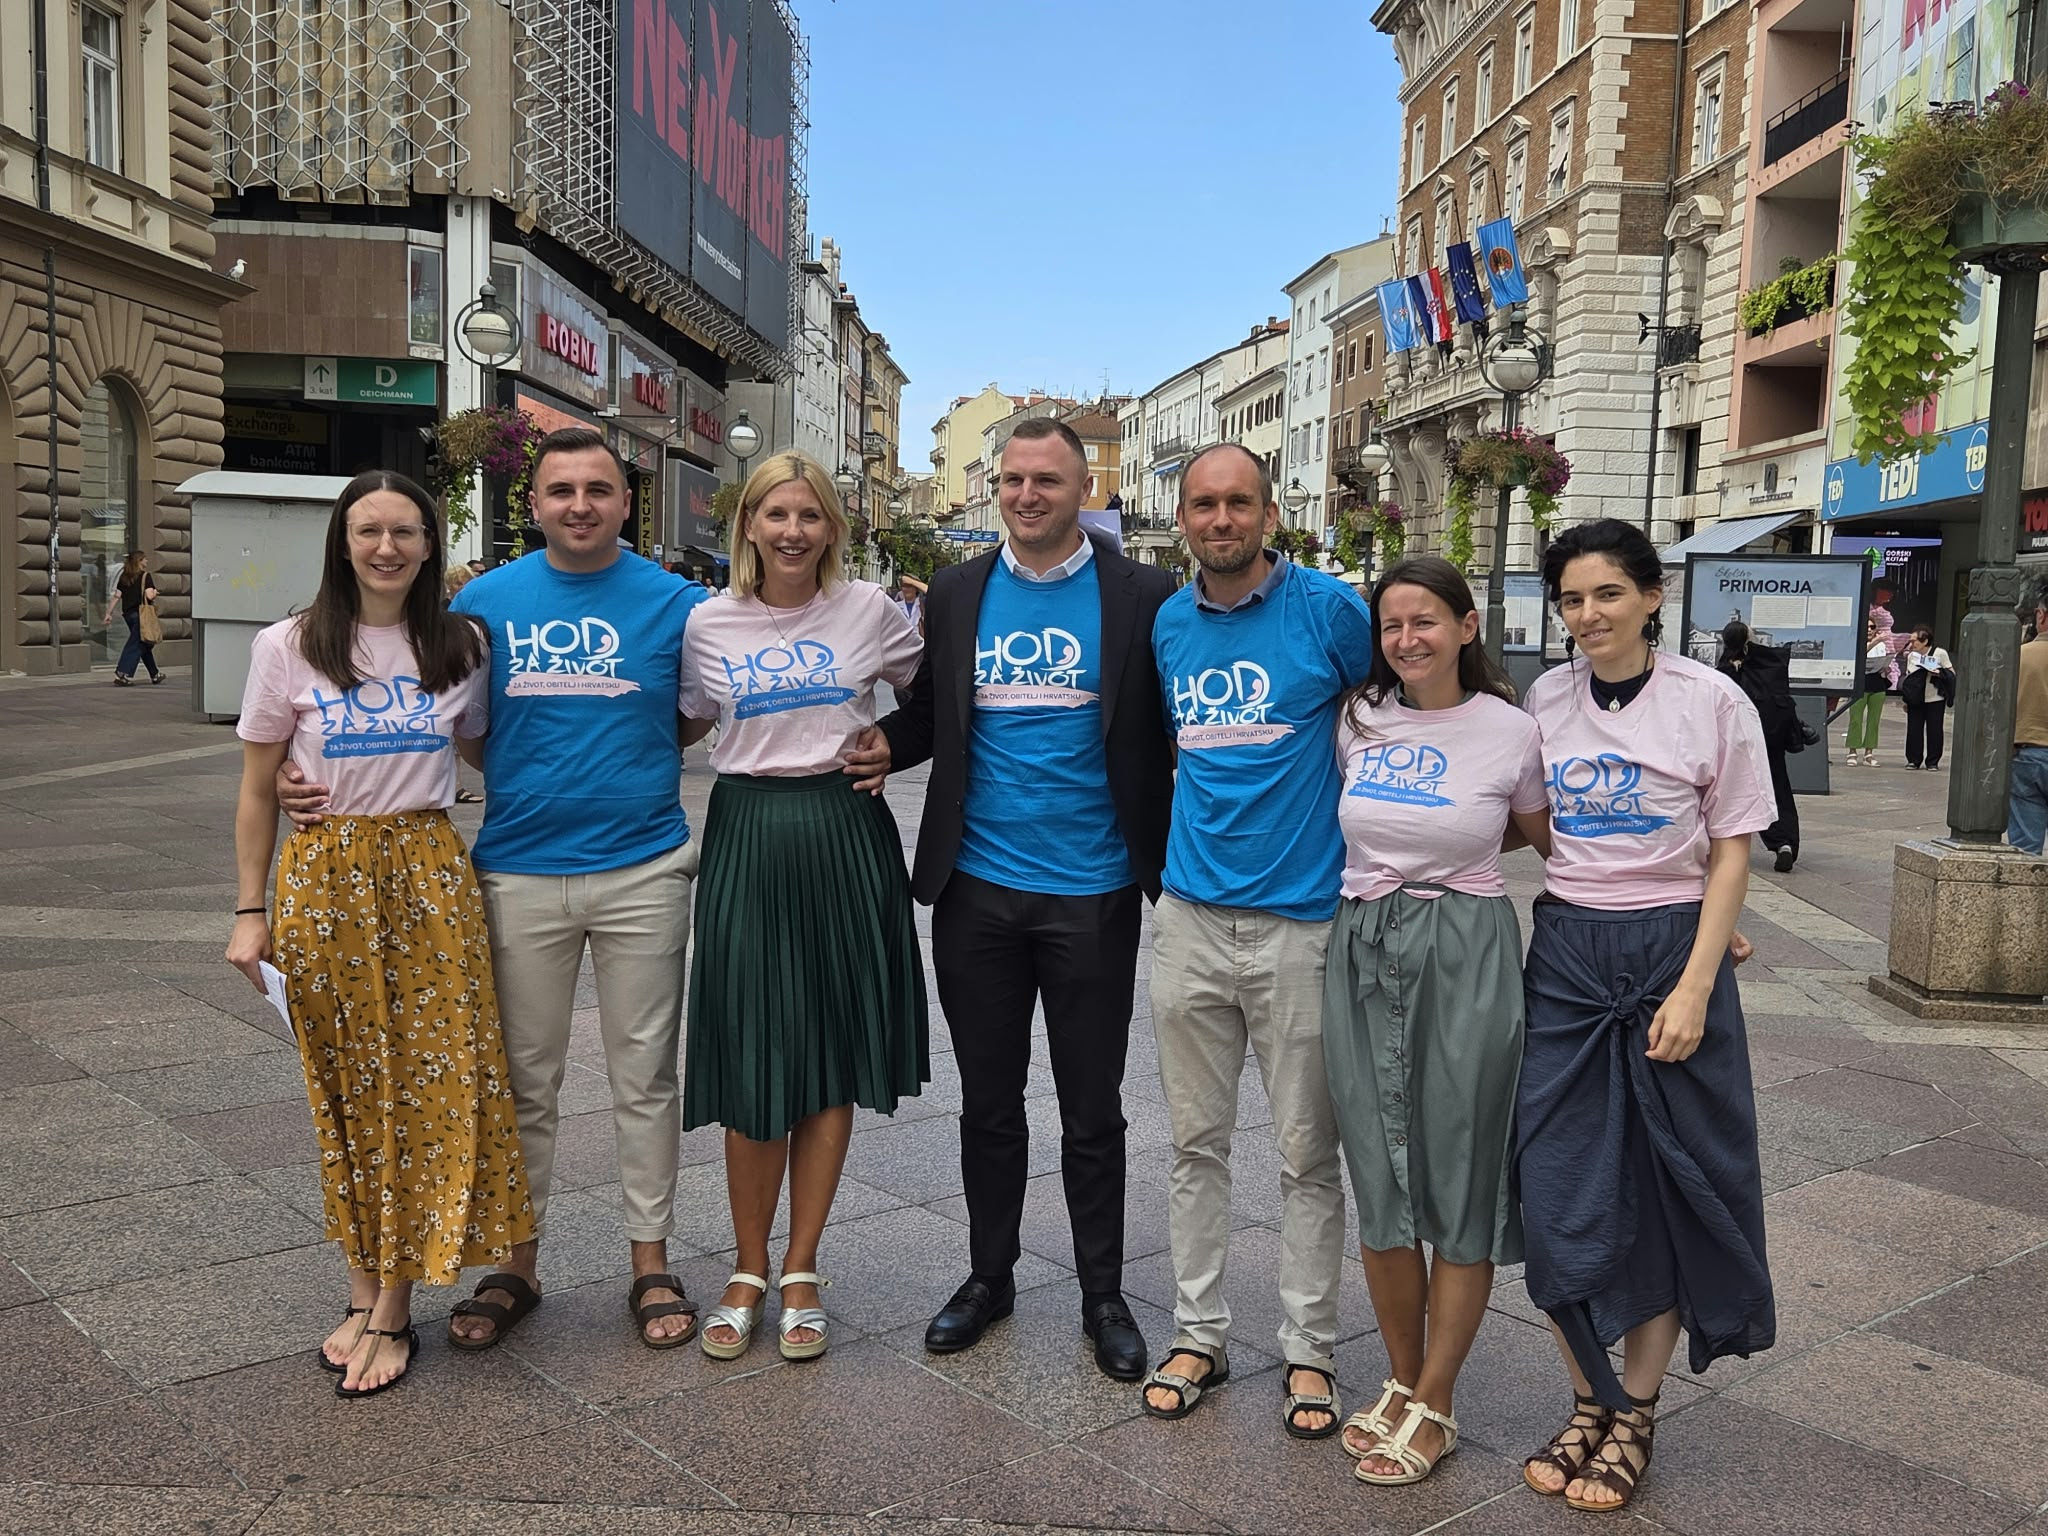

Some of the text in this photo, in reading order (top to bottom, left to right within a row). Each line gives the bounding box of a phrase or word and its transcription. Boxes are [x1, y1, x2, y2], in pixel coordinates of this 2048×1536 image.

[545, 313, 600, 375] ROBNA
[375, 365, 398, 387] D
[309, 386, 334, 395] 3. kat
[359, 389, 414, 399] DEICHMANN
[250, 454, 317, 471] bankomat
[285, 444, 317, 458] ATM
[1965, 446, 1988, 473] TED
[641, 477, 651, 526] OTKUP
[1719, 579, 1813, 594] PRIMORJA
[506, 616, 620, 660] HOD
[974, 627, 1082, 672] HOD
[508, 651, 625, 678] ZA ŽIVOT
[721, 639, 835, 685] HOD
[731, 667, 843, 700] ZA ŽIVOT
[973, 663, 1088, 689] ZA ŽIVOT
[1173, 660, 1271, 712] HOD
[312, 675, 436, 721] HOD
[321, 712, 442, 737] ZA ŽIVOT
[1204, 701, 1276, 727] ŽIVOT
[402, 738, 441, 747] HRVATSKU
[1362, 744, 1448, 780] HOD
[1544, 753, 1642, 798] HOD
[1356, 767, 1448, 794] ZA ŽIVOT
[1550, 791, 1649, 816] A ŽIVOT
